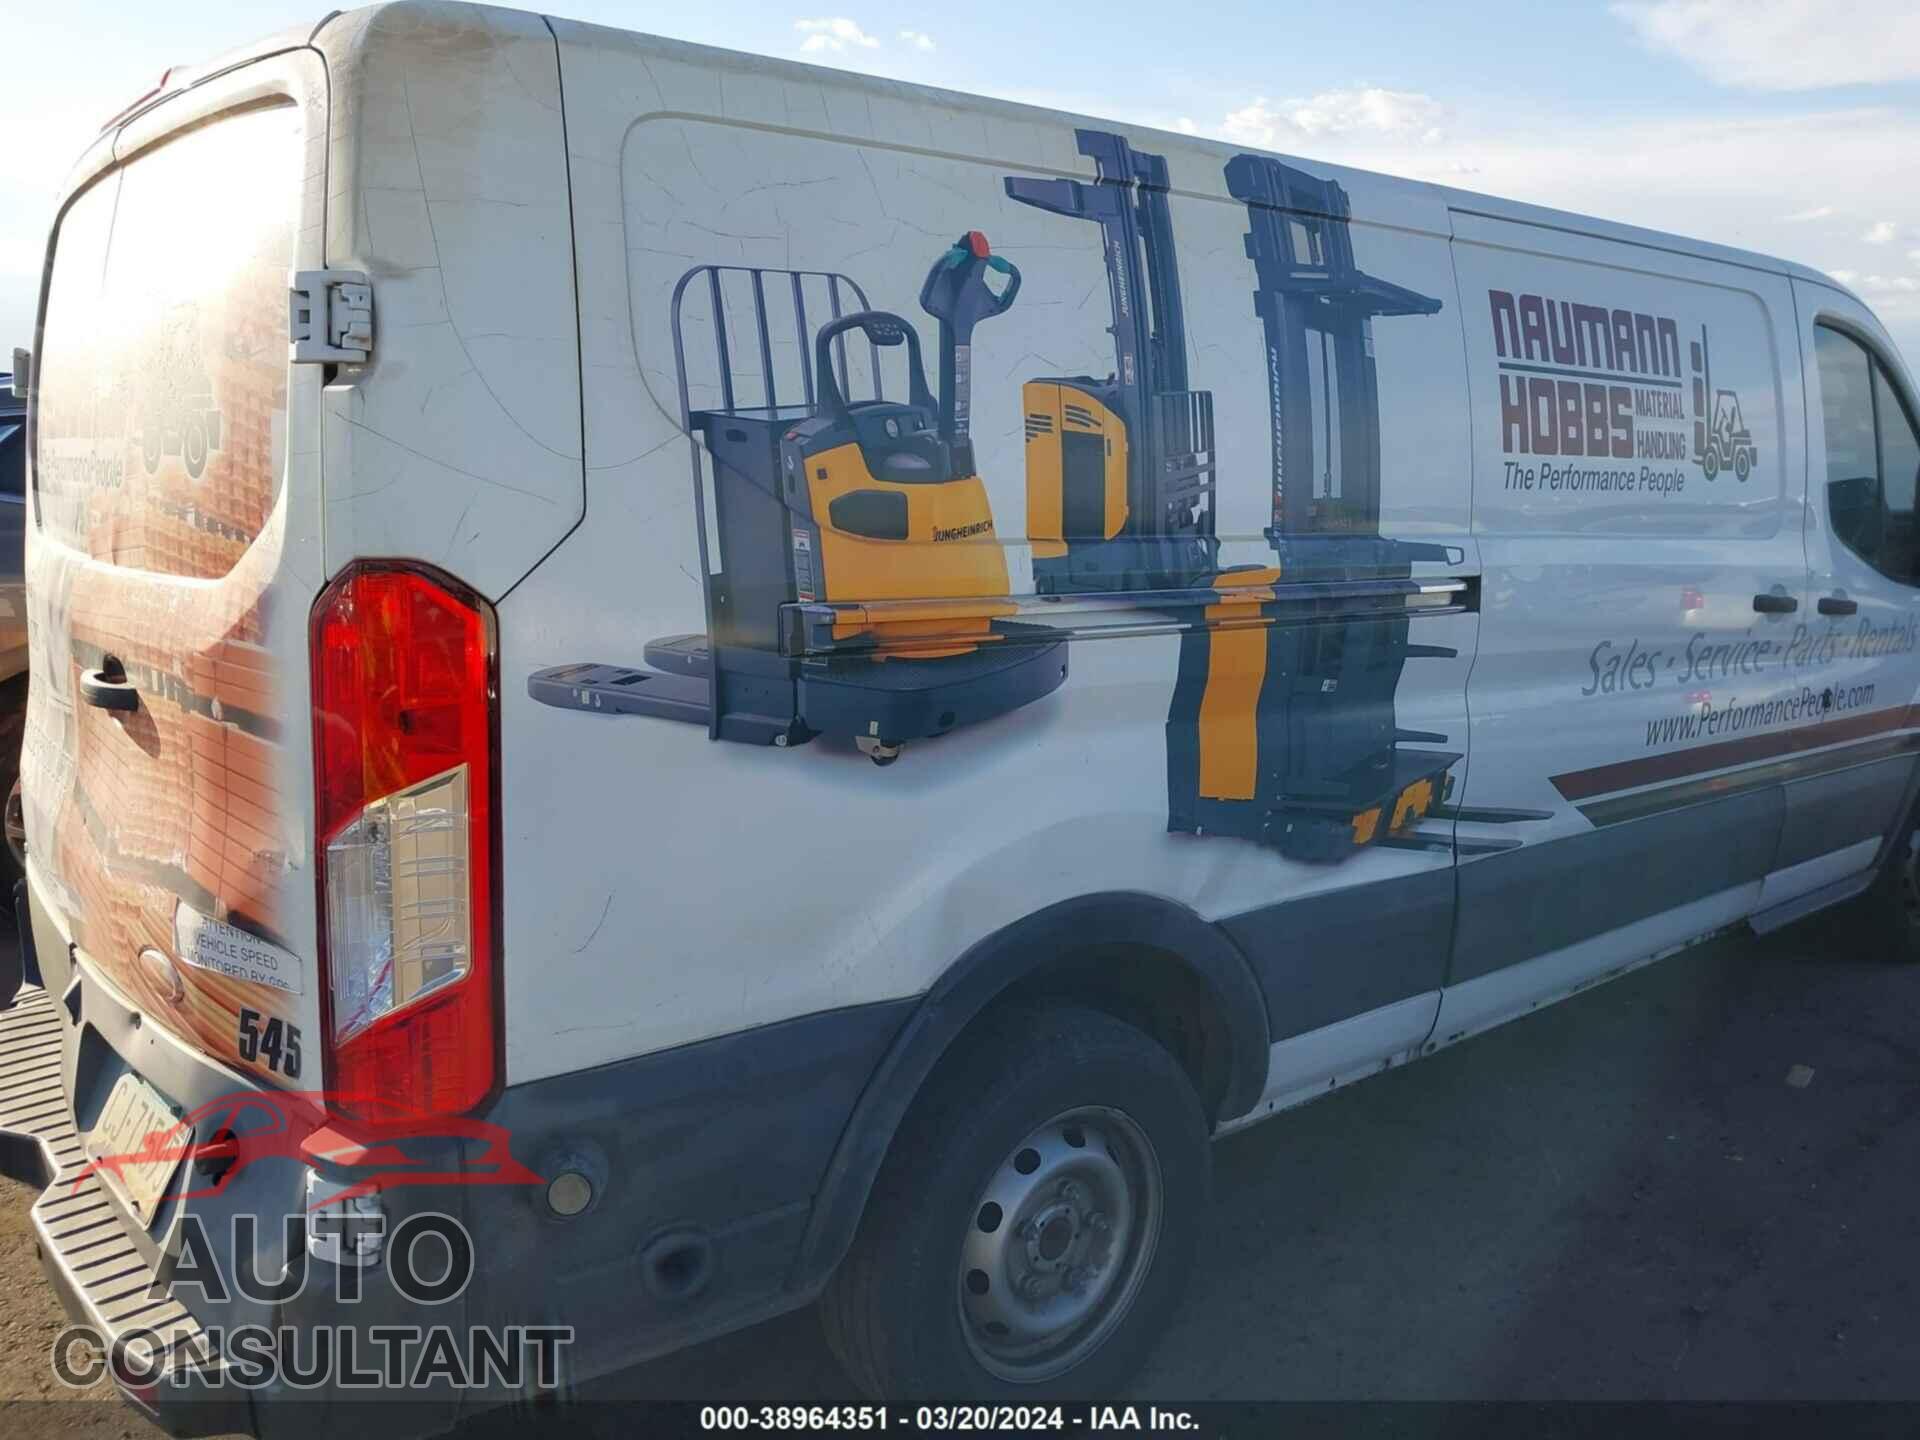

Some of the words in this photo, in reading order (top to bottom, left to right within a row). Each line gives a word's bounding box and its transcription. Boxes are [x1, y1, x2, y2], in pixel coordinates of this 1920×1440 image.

[1488, 289, 1682, 378] NAUMANN
[1499, 374, 1634, 459] HOBBS
[1635, 389, 1685, 420] MATERIAL
[1636, 431, 1686, 460] HANDLING
[1503, 461, 1534, 491] The
[1538, 463, 1636, 493] Performance
[1638, 465, 1685, 498] People
[1582, 638, 1662, 696] Sales
[1677, 630, 1772, 684] Service
[1784, 623, 1841, 670] Parts
[1645, 682, 1875, 747] www.PerformancePeople.com
[239, 946, 279, 971] SPEED
[239, 1008, 302, 1079] 545
